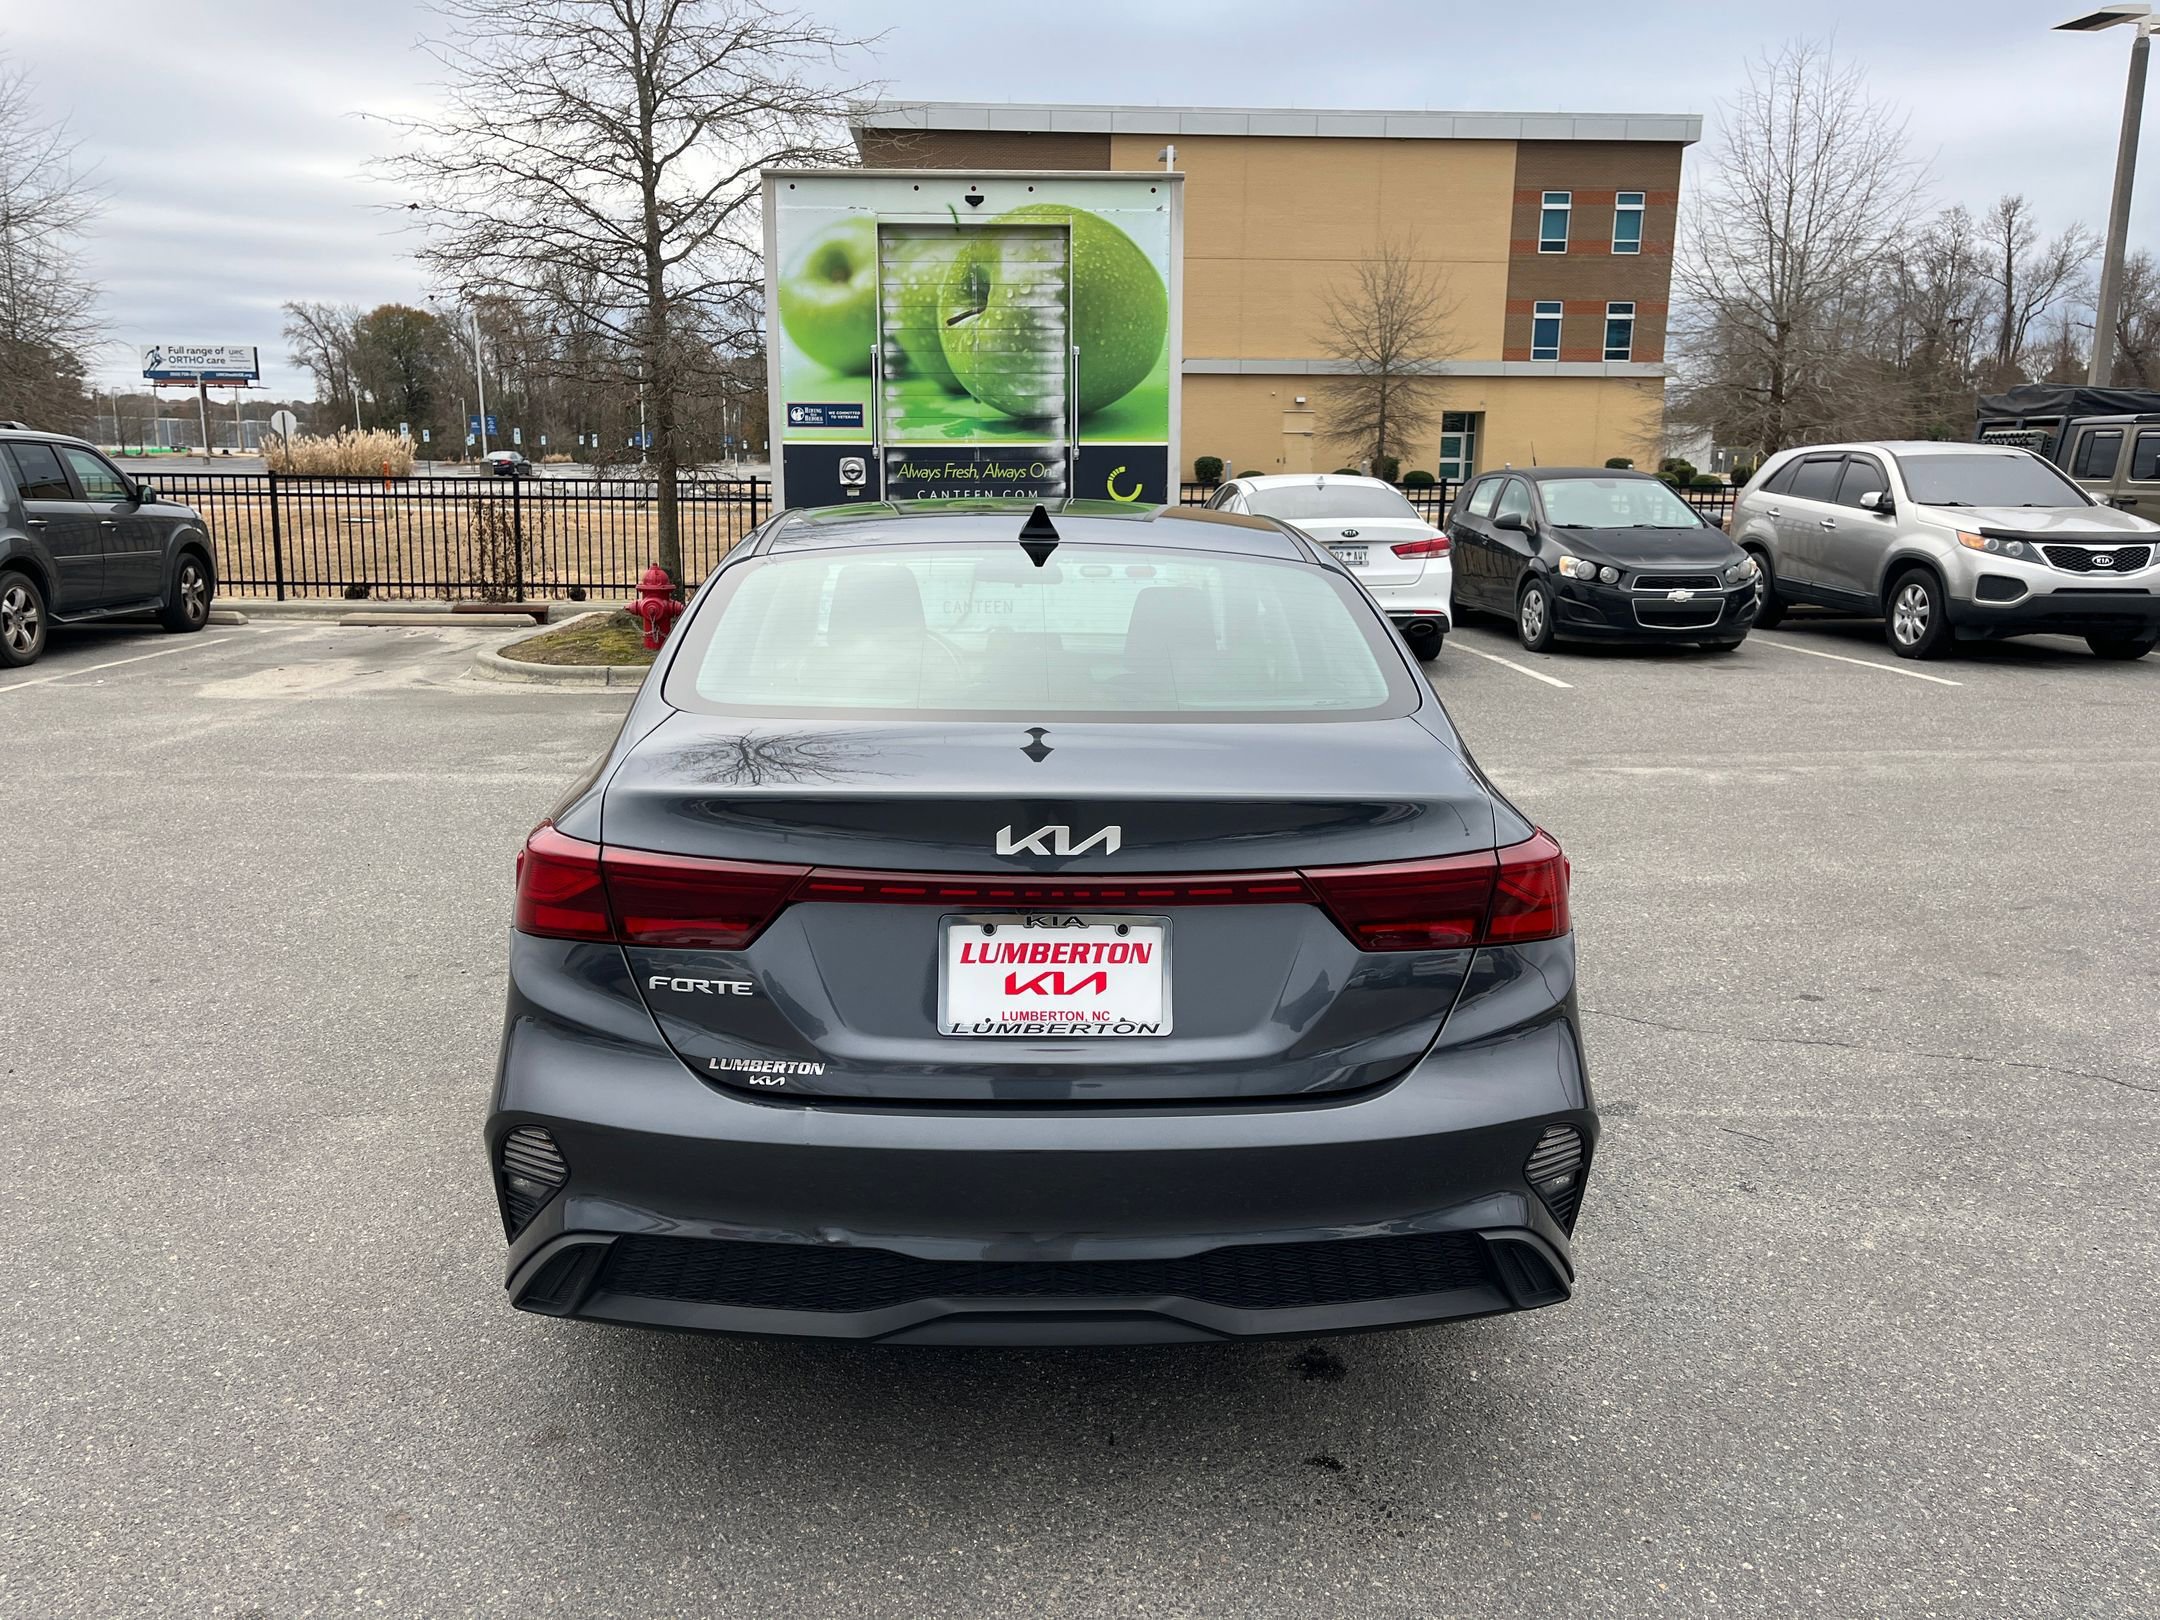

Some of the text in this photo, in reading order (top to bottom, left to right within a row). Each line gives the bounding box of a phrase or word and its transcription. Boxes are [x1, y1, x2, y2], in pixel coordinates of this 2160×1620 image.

[168, 346, 225, 357] Full range of
[168, 356, 226, 365] ORTHO care
[897, 463, 941, 482] Always
[944, 462, 980, 480] Fresh,
[982, 462, 1027, 482] Always
[1353, 551, 1368, 561] AWY
[943, 600, 1013, 614] CANTEEN
[1026, 916, 1086, 927] KIA
[960, 943, 1152, 964] LUMBERTON
[649, 976, 753, 996] FORTE
[1001, 1011, 1111, 1022] LUMBERTON, NC
[951, 1023, 1160, 1034] LUMBERTON
[709, 1058, 825, 1075] LUMBERTON
